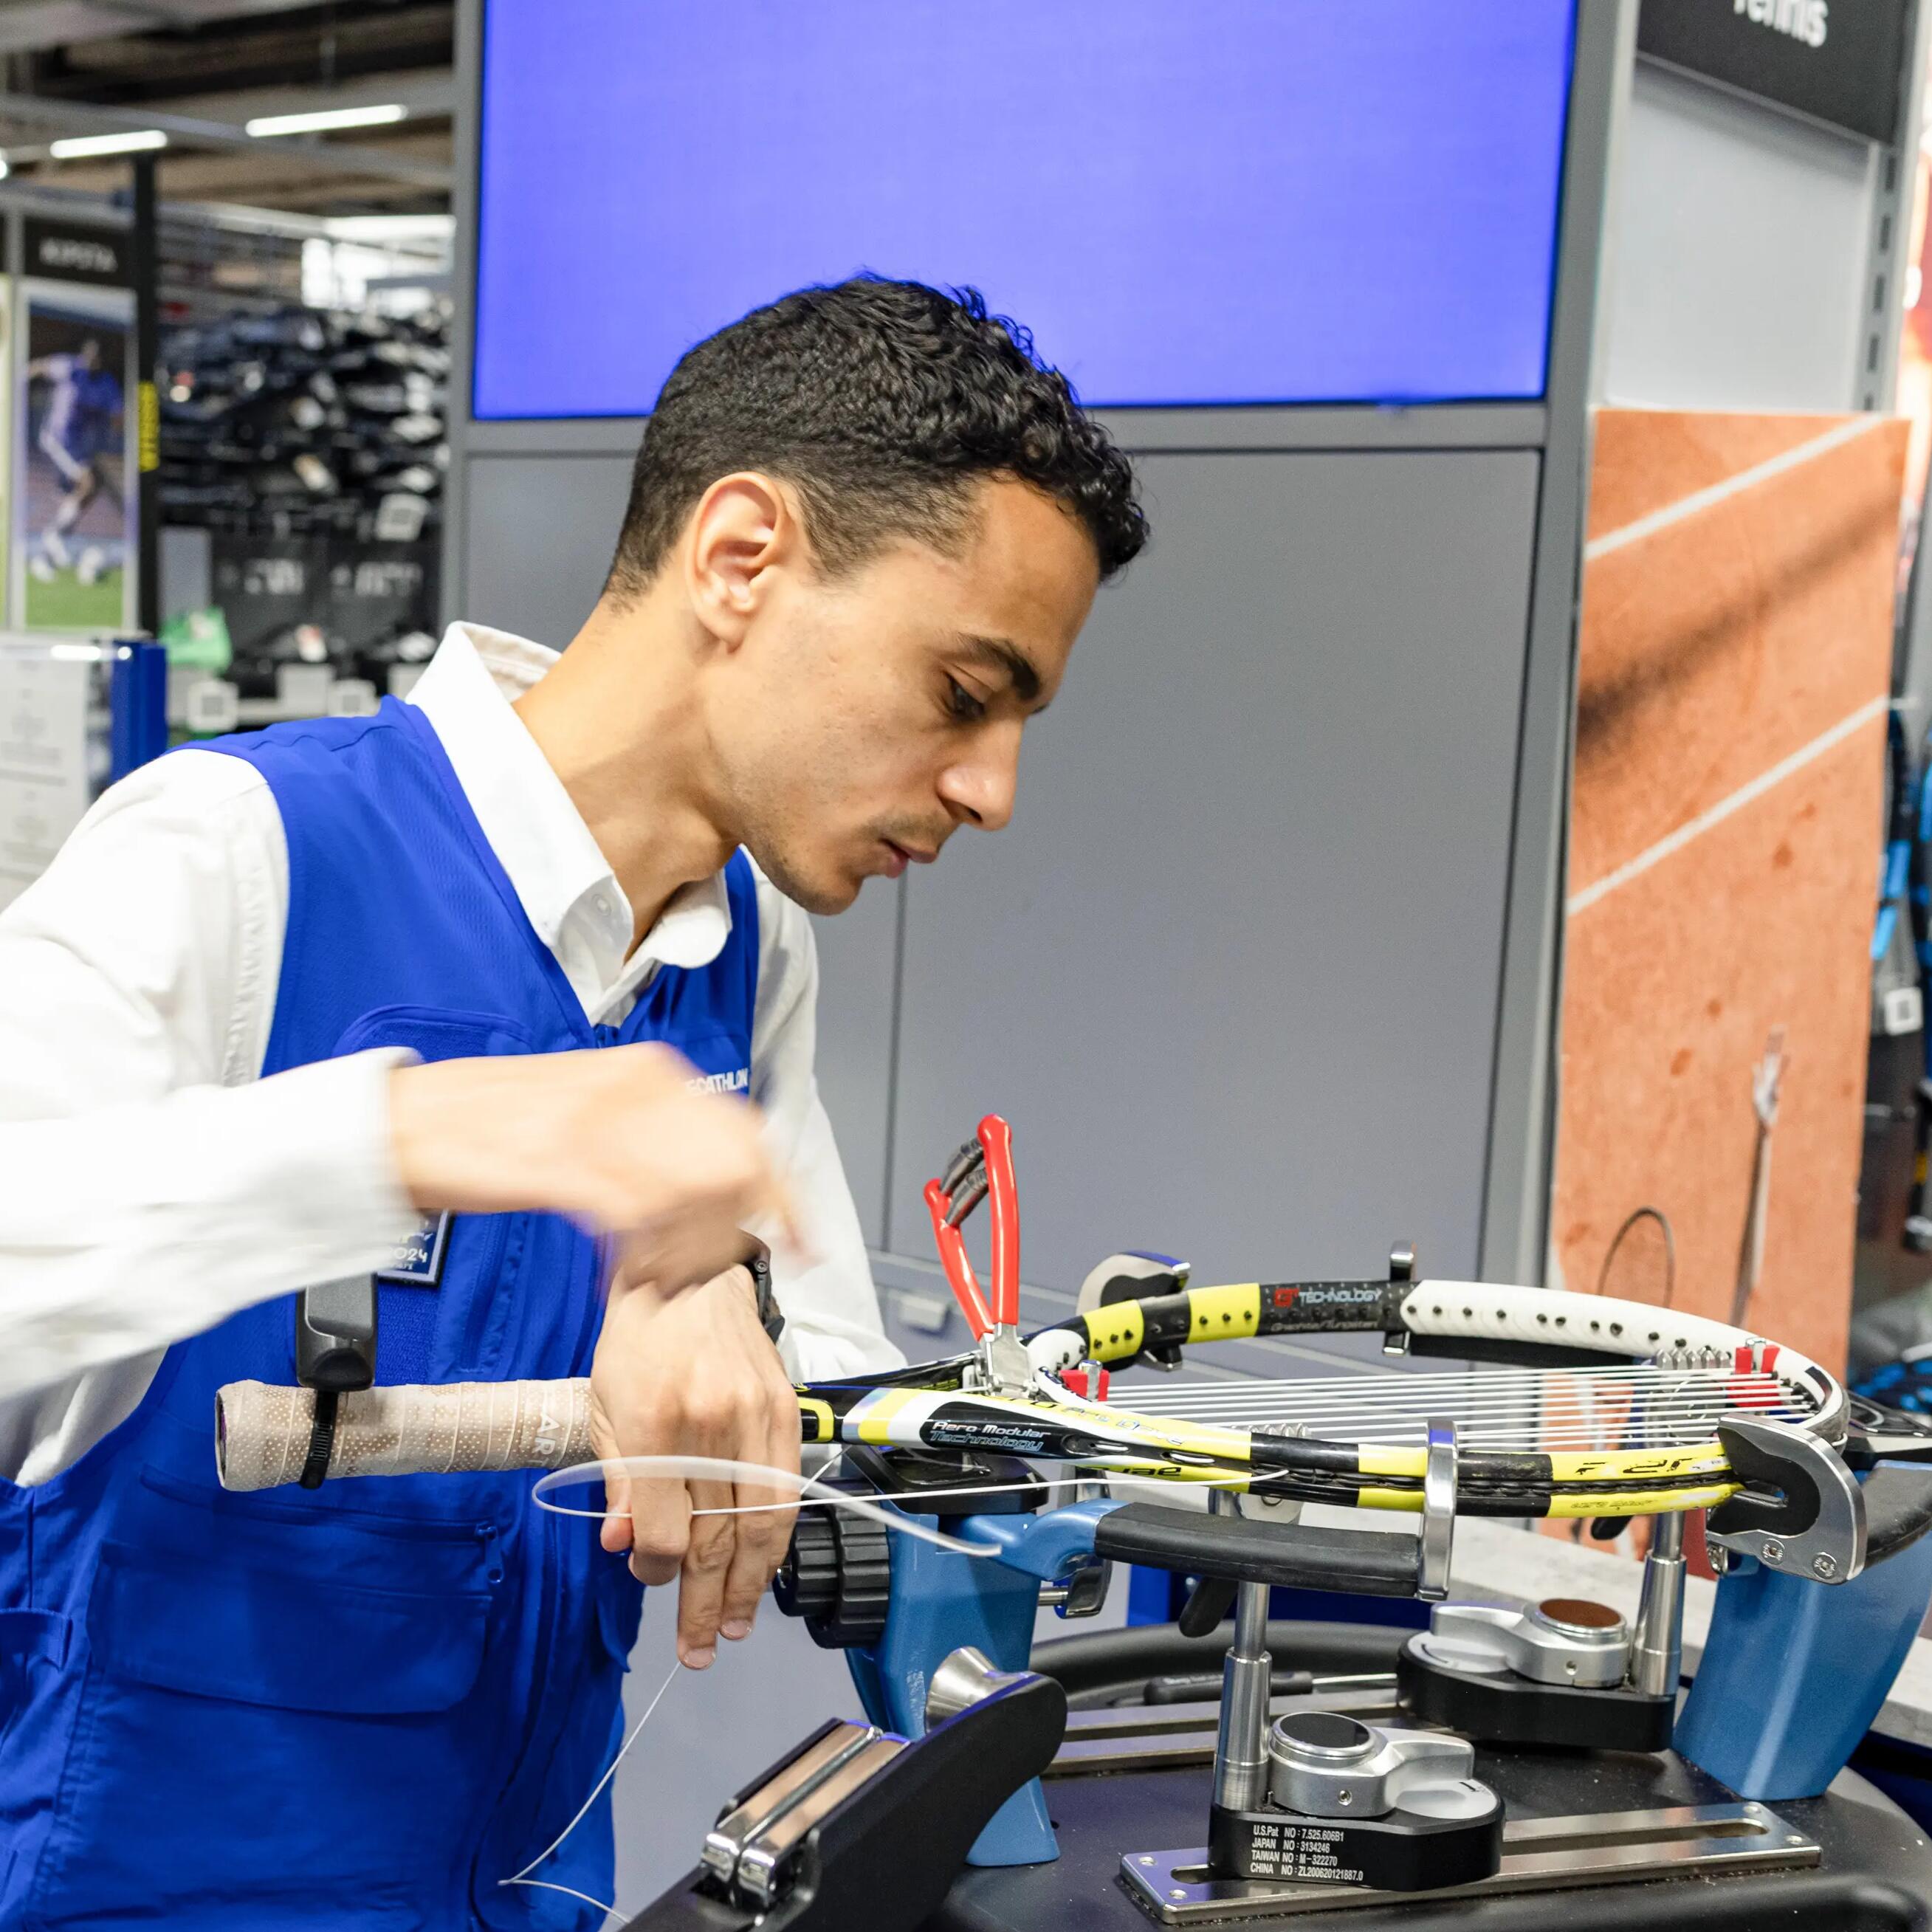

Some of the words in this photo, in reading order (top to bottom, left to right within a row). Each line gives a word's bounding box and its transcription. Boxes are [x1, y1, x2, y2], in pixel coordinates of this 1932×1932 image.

[1734, 0, 1828, 47] ennis
[685, 1068, 748, 1094] ECATHLON
[390, 1247, 428, 1262] 024
[1299, 1289, 1383, 1307] TECHNOLOGY
[929, 1430, 1044, 1452] Technology
[1253, 1825, 1279, 1837] U.S.Pat
[1302, 1829, 1344, 1842] 7.525.606B1
[1251, 1838, 1276, 1849] JAPAN
[1300, 1841, 1330, 1853] 3134246
[1251, 1850, 1280, 1862] TAIWAN
[1250, 1863, 1273, 1874] CHINA
